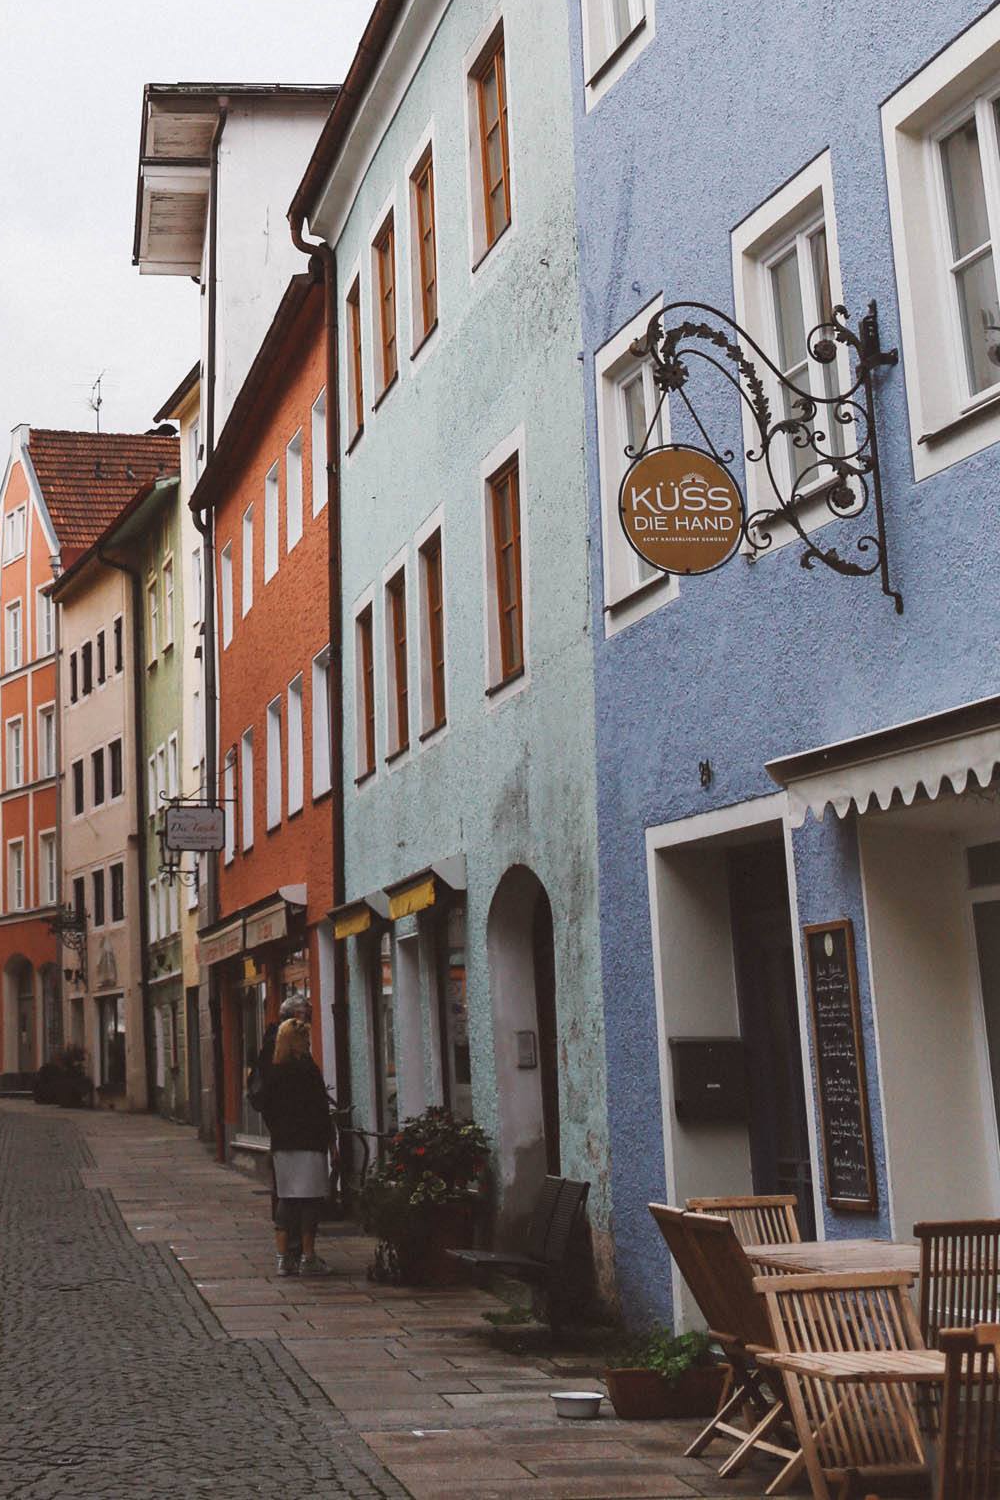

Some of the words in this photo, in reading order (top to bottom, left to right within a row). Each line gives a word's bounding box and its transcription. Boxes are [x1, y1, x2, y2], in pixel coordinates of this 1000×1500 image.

[631, 481, 733, 514] KÜSS
[634, 516, 669, 531] DIE
[675, 516, 734, 531] HAND
